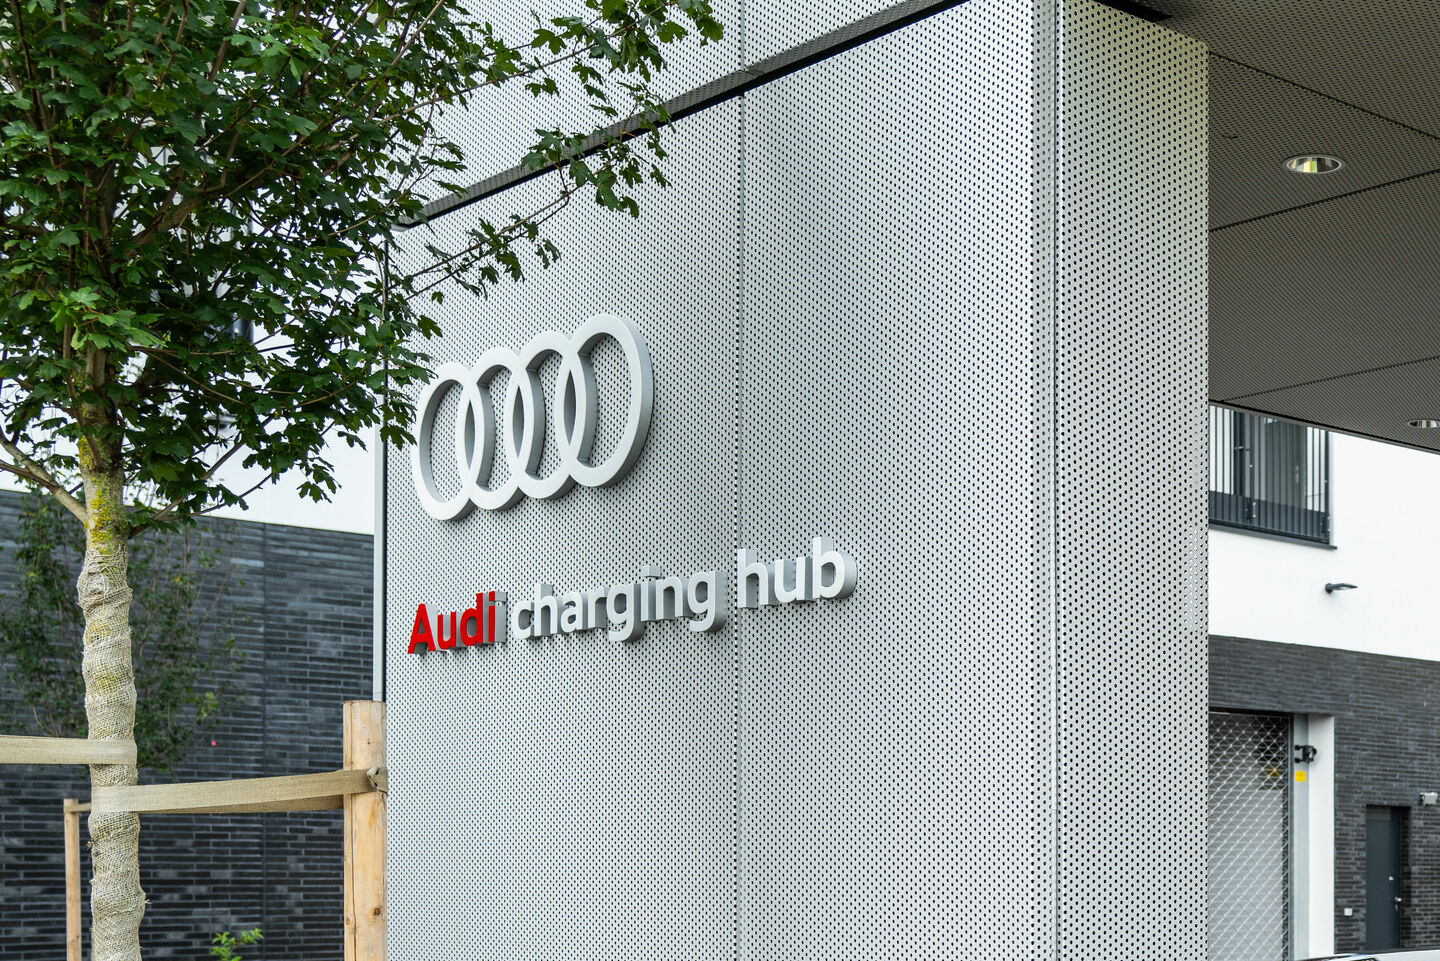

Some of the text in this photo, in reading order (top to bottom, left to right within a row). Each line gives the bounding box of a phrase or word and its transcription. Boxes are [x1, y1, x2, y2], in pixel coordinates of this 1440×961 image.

[407, 536, 858, 655] Audi charging hub
